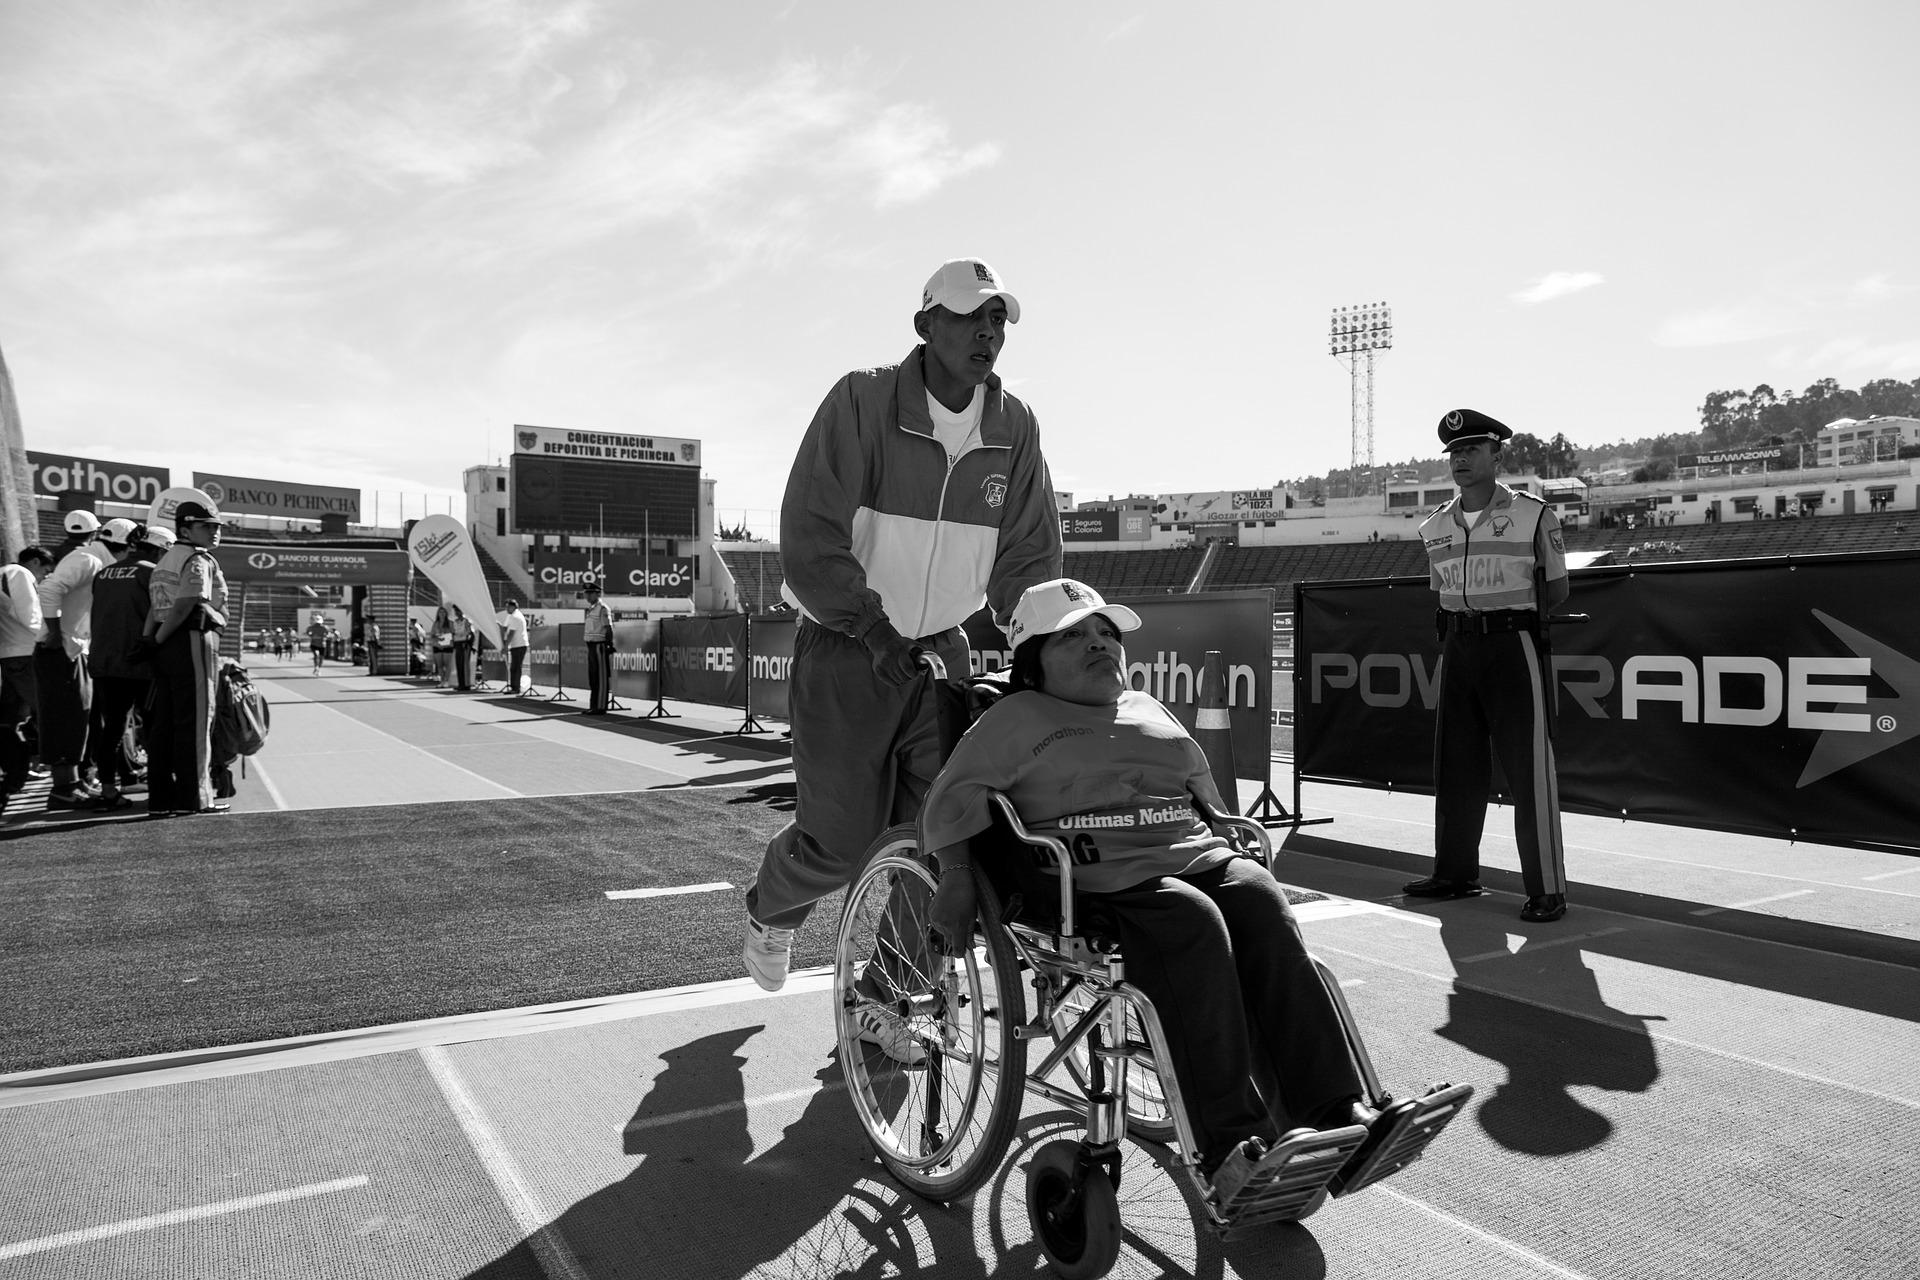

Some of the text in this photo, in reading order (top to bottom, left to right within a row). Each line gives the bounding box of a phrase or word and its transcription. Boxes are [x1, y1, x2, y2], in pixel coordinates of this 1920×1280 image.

[567, 432, 654, 449] CONCENTRACION
[544, 442, 676, 462] DEPORTIVA DE PICHINCHA
[1696, 449, 1781, 464] TELEAMAZONAS
[228, 488, 357, 513] BANCO PICHINCHA
[1249, 490, 1273, 499] LA RED
[278, 554, 308, 562] BANCO
[321, 555, 367, 564] GUAYAQUIL
[99, 566, 139, 580] JUEZ
[541, 567, 681, 586] Claro Claro
[1442, 557, 1505, 590] POLICIA
[613, 648, 658, 672] marathon
[664, 646, 734, 672] POWERADE
[1126, 651, 1256, 707] athn
[1032, 726, 1095, 757] marathon
